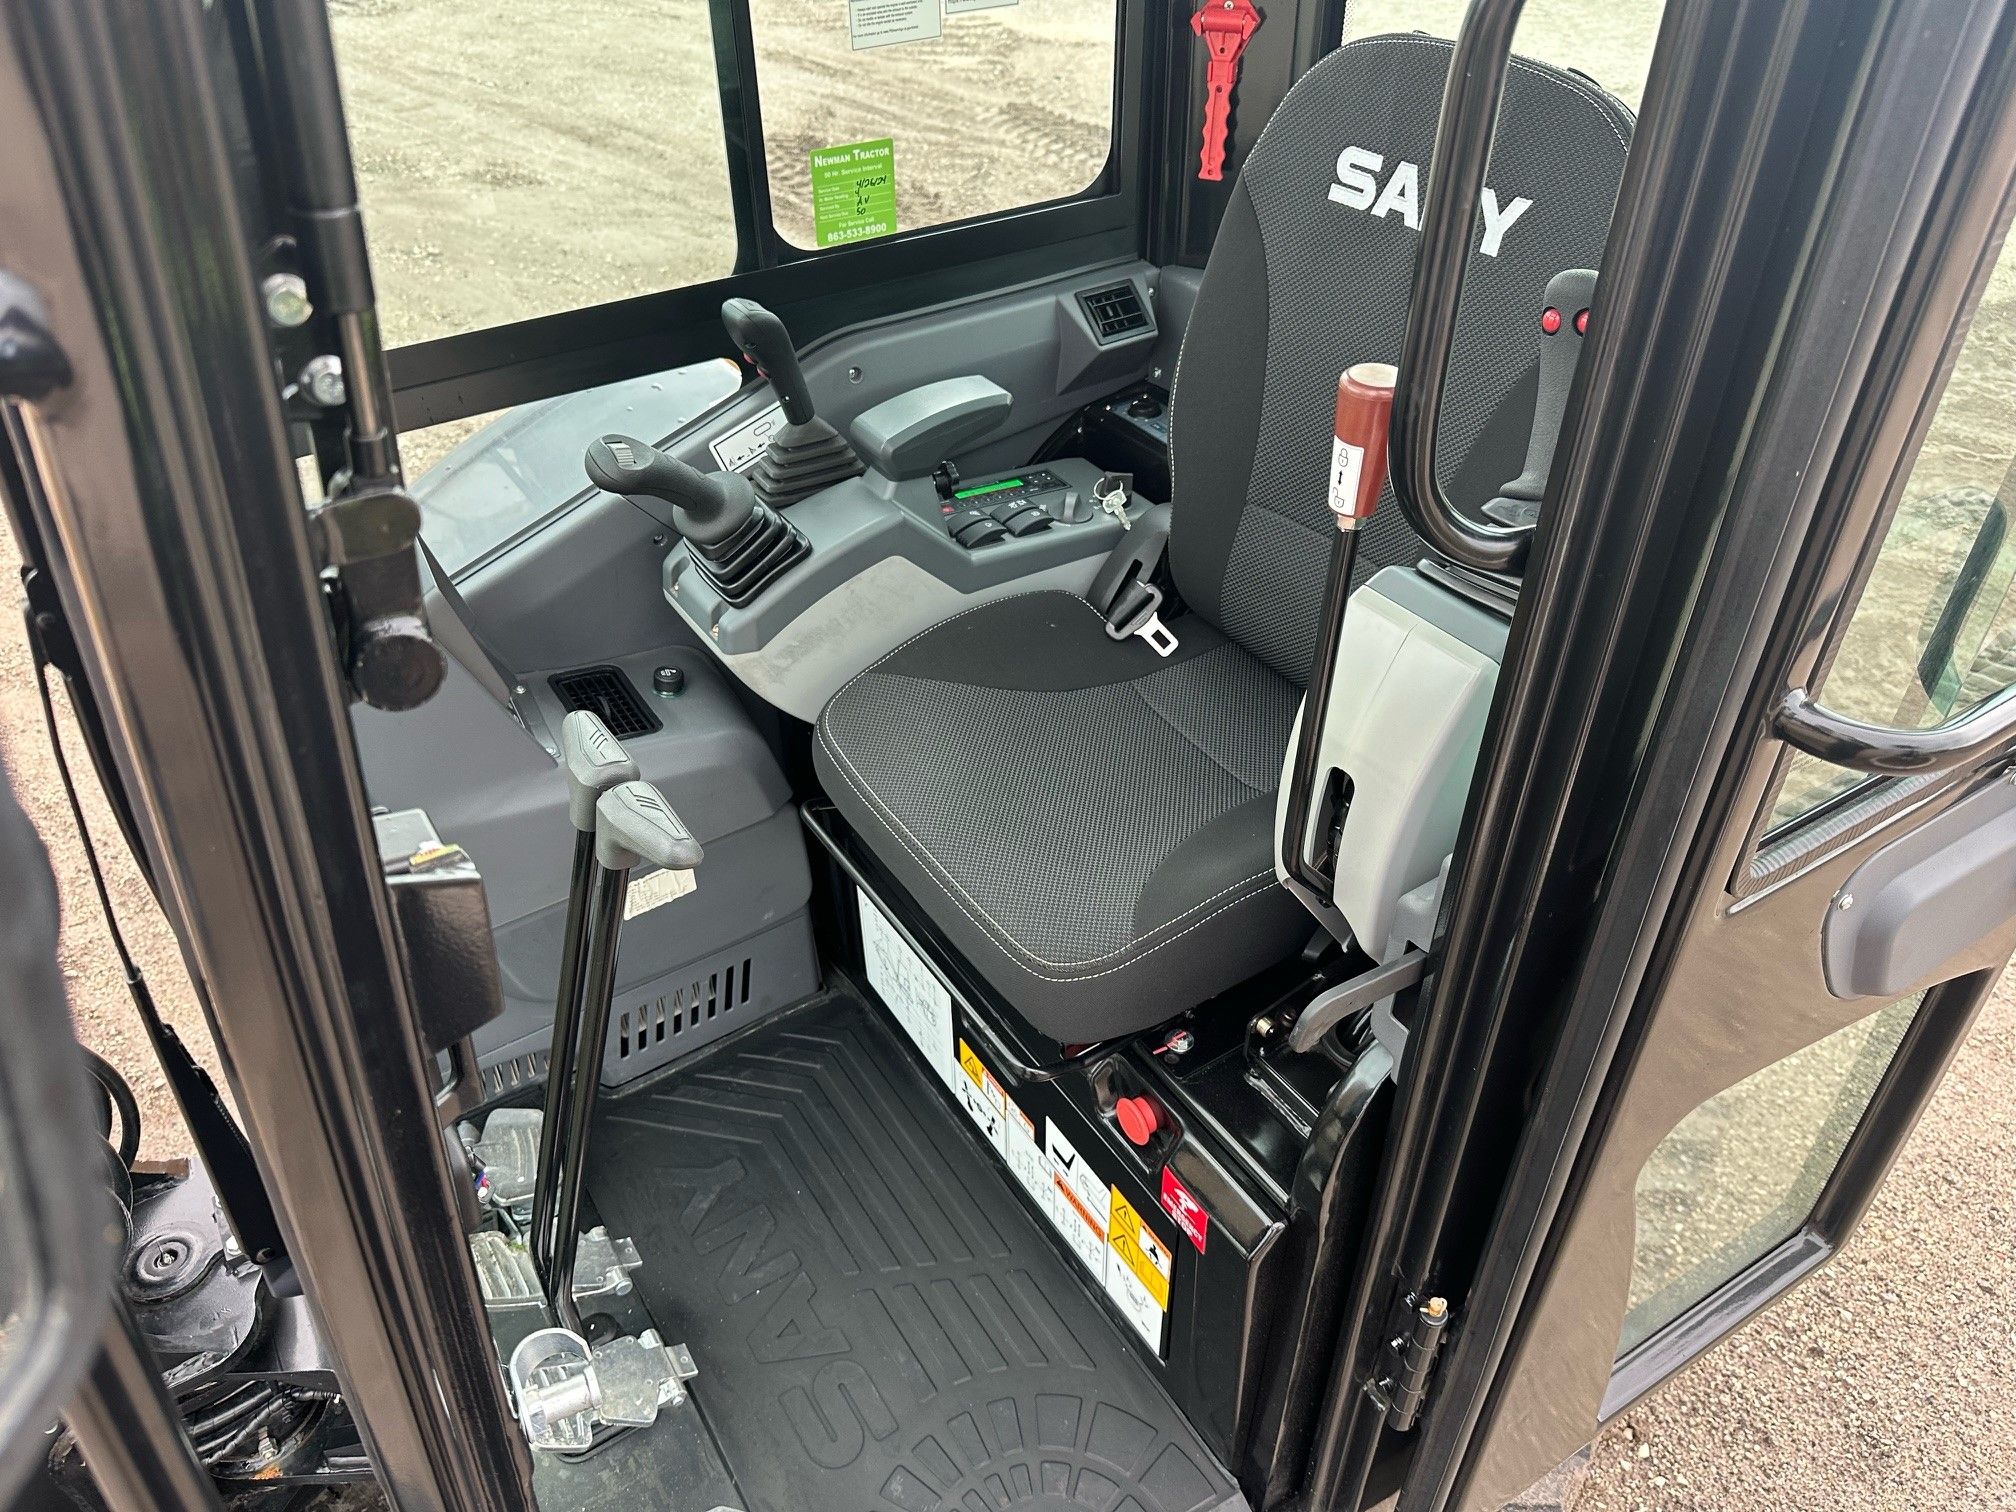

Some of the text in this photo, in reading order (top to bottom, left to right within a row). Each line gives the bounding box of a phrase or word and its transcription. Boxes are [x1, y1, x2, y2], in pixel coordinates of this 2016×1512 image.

[828, 223, 887, 242] 863-533-8900
[1327, 145, 1534, 258] SAY
[652, 1155, 899, 1470] SANY
